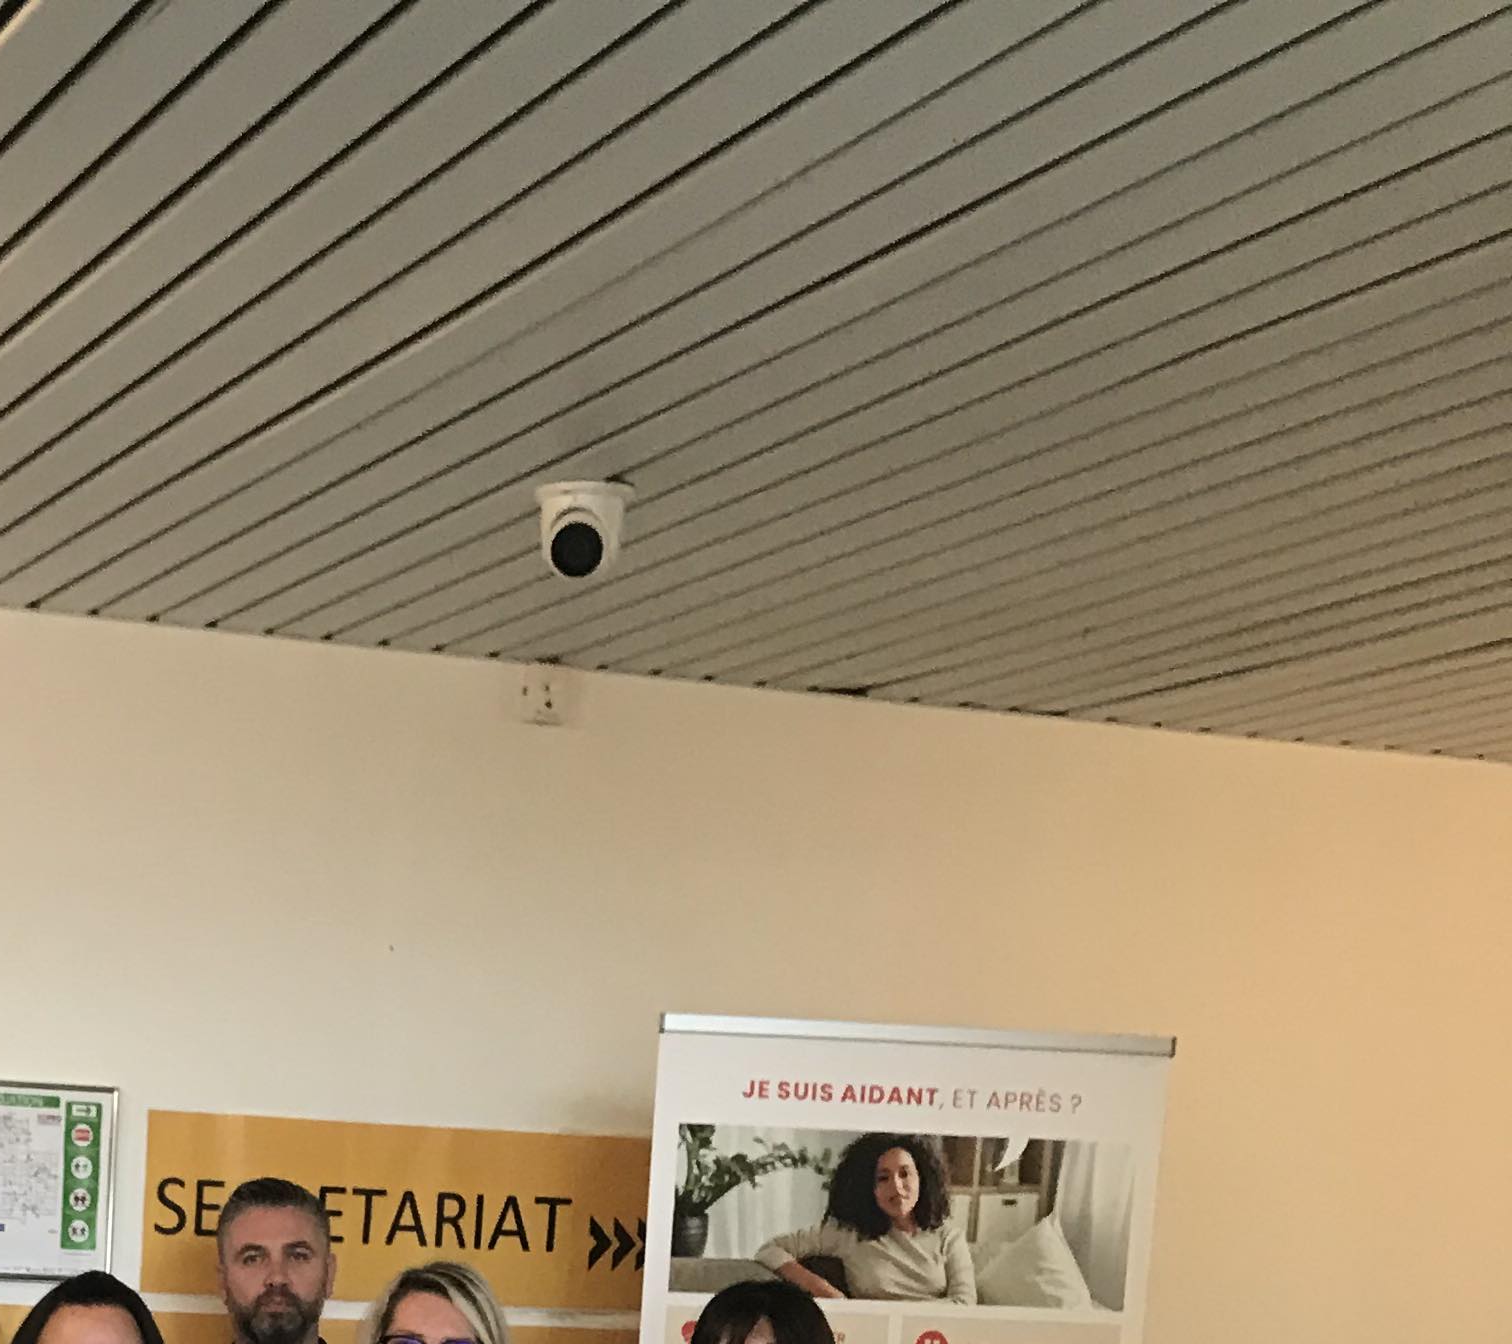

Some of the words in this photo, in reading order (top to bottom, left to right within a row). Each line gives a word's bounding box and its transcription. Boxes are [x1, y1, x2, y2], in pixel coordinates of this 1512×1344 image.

[742, 1079, 770, 1100] JE
[777, 1081, 834, 1102] SUIS
[841, 1084, 945, 1110] AIDANT,
[953, 1088, 978, 1110] ET
[986, 1087, 1063, 1114] APRÈS
[1070, 1093, 1083, 1115] ?
[154, 1177, 573, 1254] SEETARIAT
